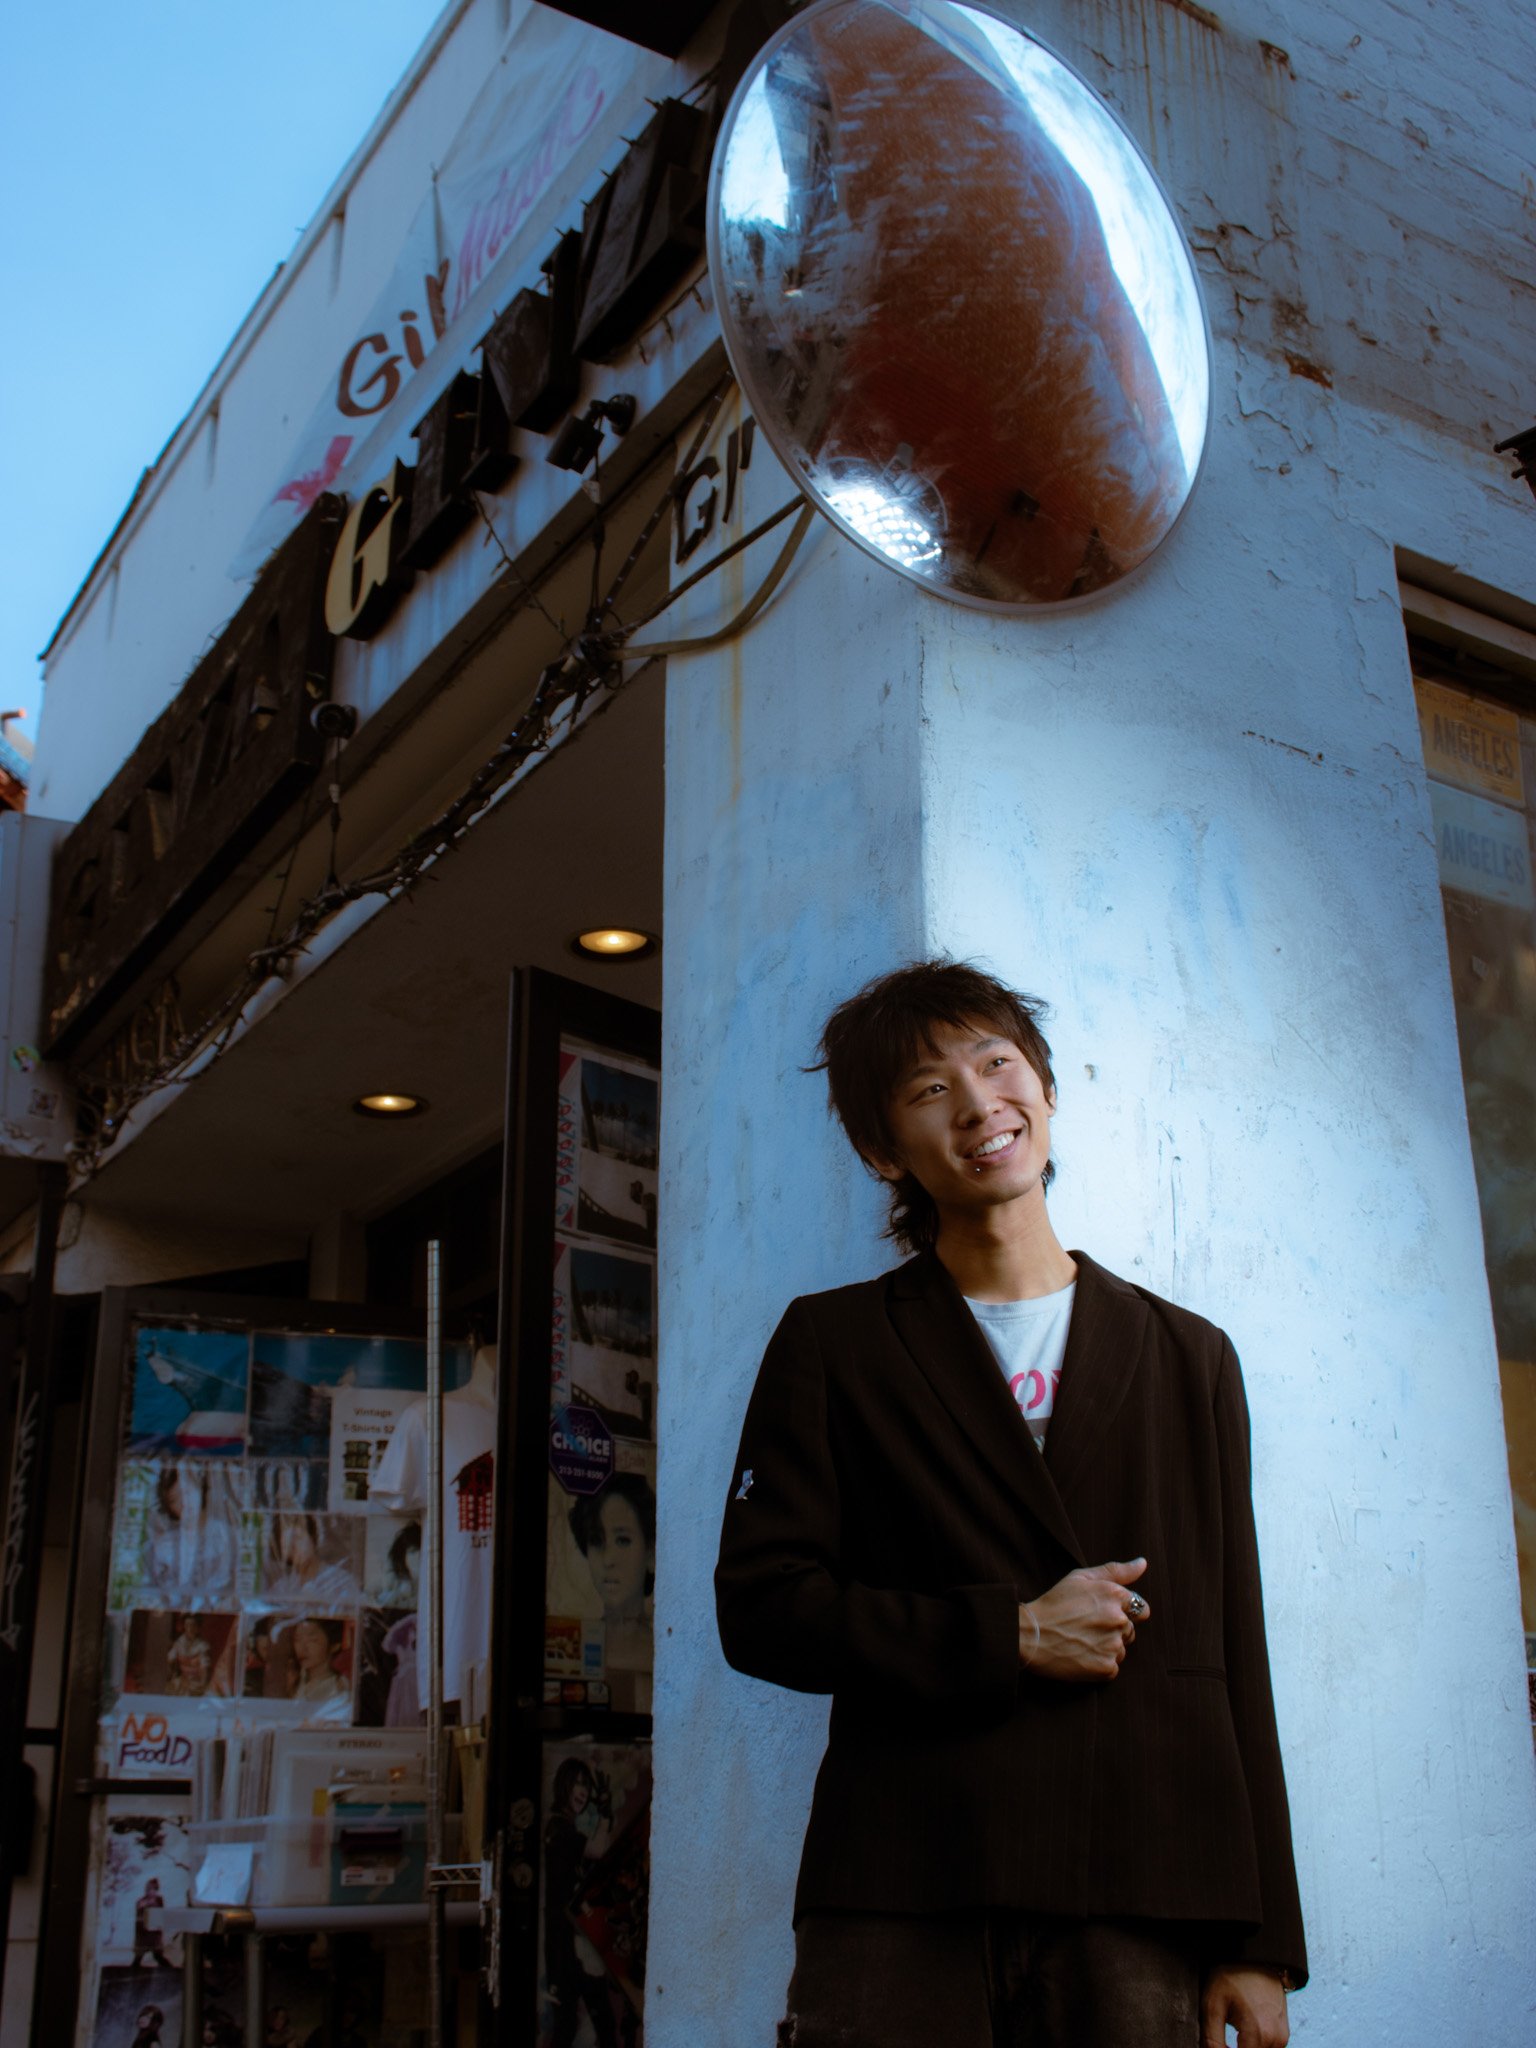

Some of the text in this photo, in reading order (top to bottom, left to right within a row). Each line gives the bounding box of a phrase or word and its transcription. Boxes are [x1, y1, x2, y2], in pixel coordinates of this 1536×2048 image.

[1433, 712, 1515, 780] ANGELES
[1442, 821, 1527, 886] ANGELES
[354, 1407, 393, 1418] Vintage
[343, 1423, 381, 1434] T-Shirts
[551, 1431, 610, 1457] CHOICE
[121, 1712, 168, 1744] NO
[119, 1736, 171, 1767] Food
